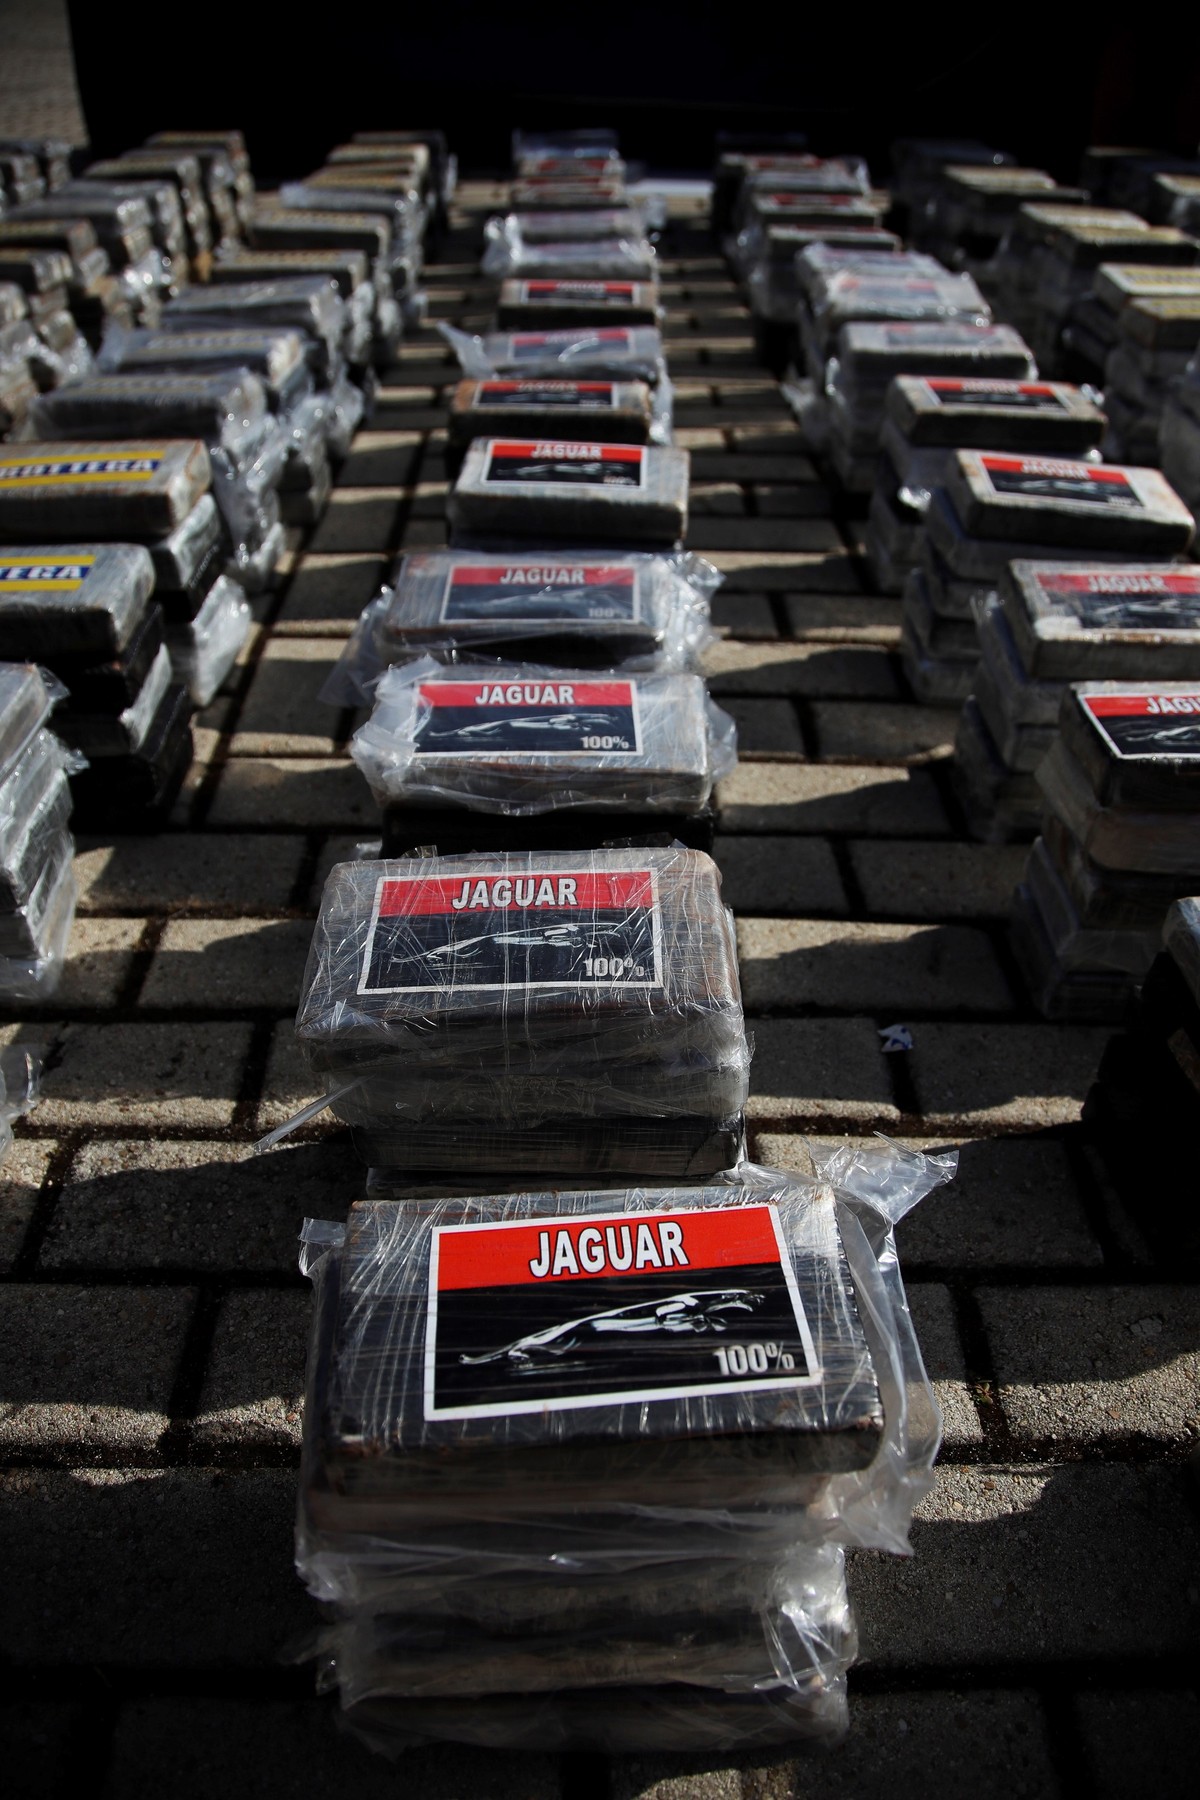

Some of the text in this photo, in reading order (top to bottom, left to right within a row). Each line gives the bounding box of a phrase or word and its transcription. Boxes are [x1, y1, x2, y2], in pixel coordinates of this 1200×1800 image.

[531, 443, 602, 459] JAGUAR
[500, 567, 586, 585] JAGUAR
[1088, 575, 1167, 592] JAGUAR
[475, 685, 575, 705] JAGUAR
[580, 735, 629, 749] 100%
[452, 878, 578, 909] JAGUAR
[583, 957, 645, 977] 100%
[529, 1221, 690, 1278] JAGUAR
[712, 1343, 795, 1376] 100%
